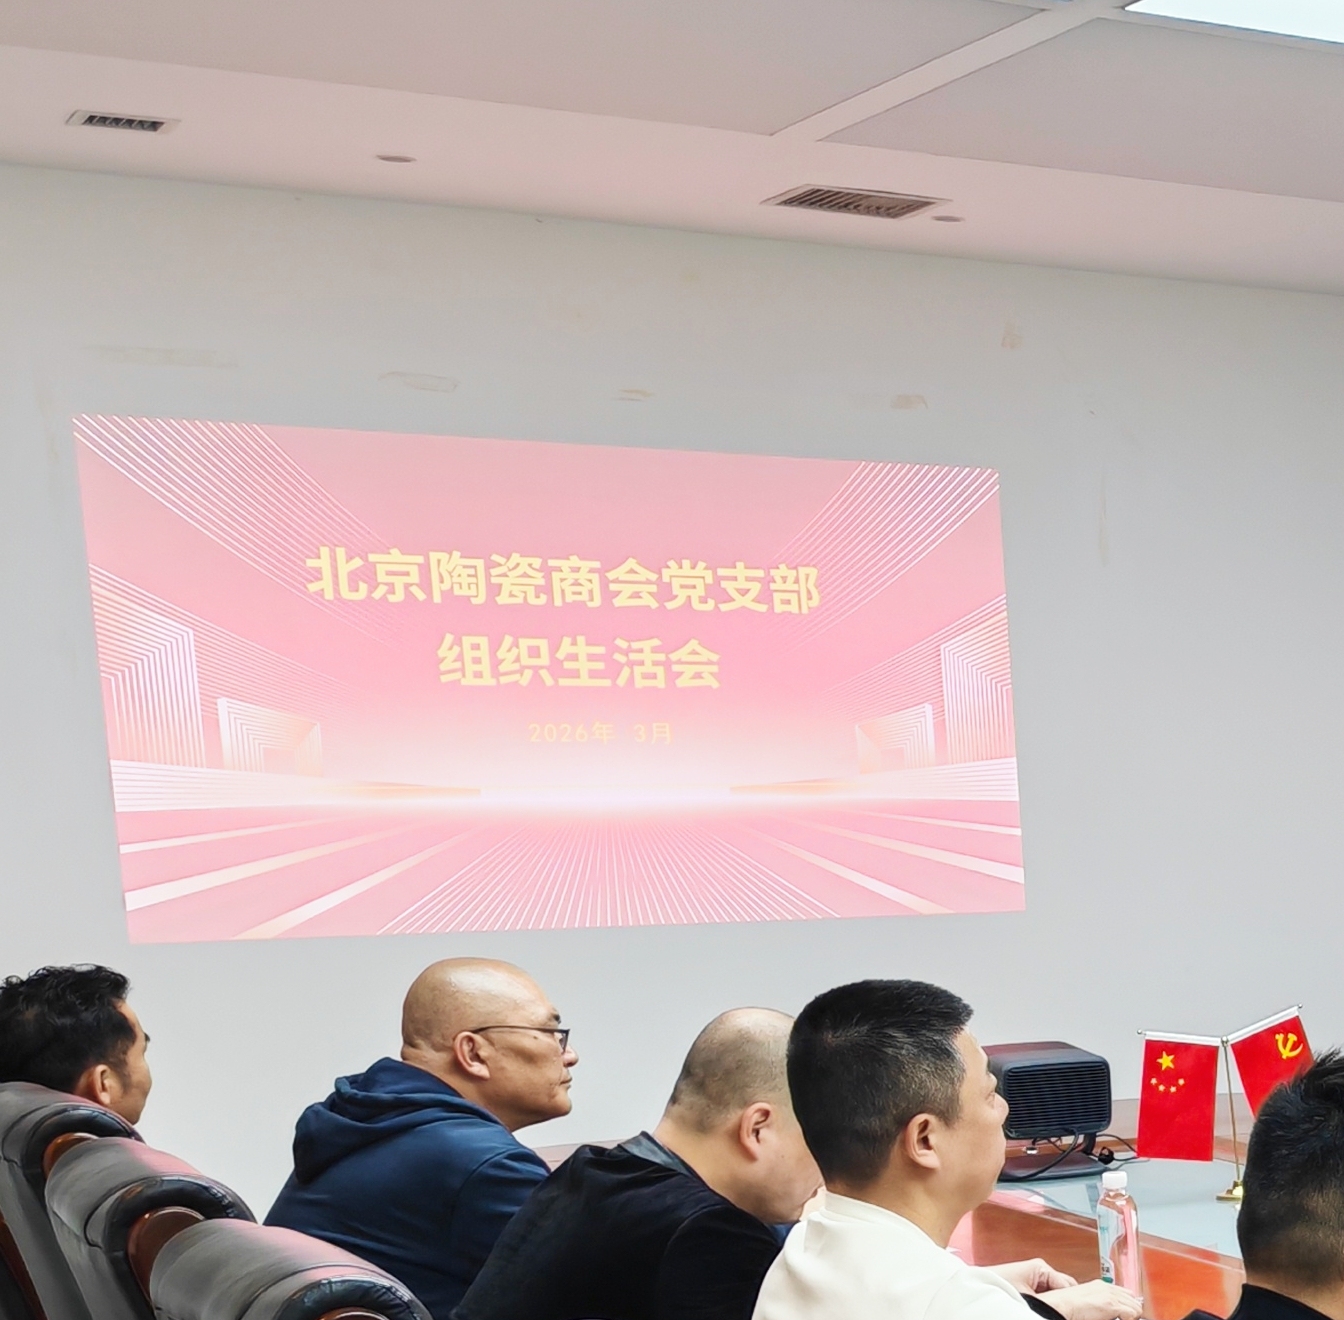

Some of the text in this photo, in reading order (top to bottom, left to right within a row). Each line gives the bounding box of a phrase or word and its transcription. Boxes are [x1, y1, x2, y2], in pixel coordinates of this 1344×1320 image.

[305, 545, 821, 615] 北京陶瓷商会党支部
[437, 633, 722, 690] 组织生活会
[528, 719, 674, 745] 2026年 3月
